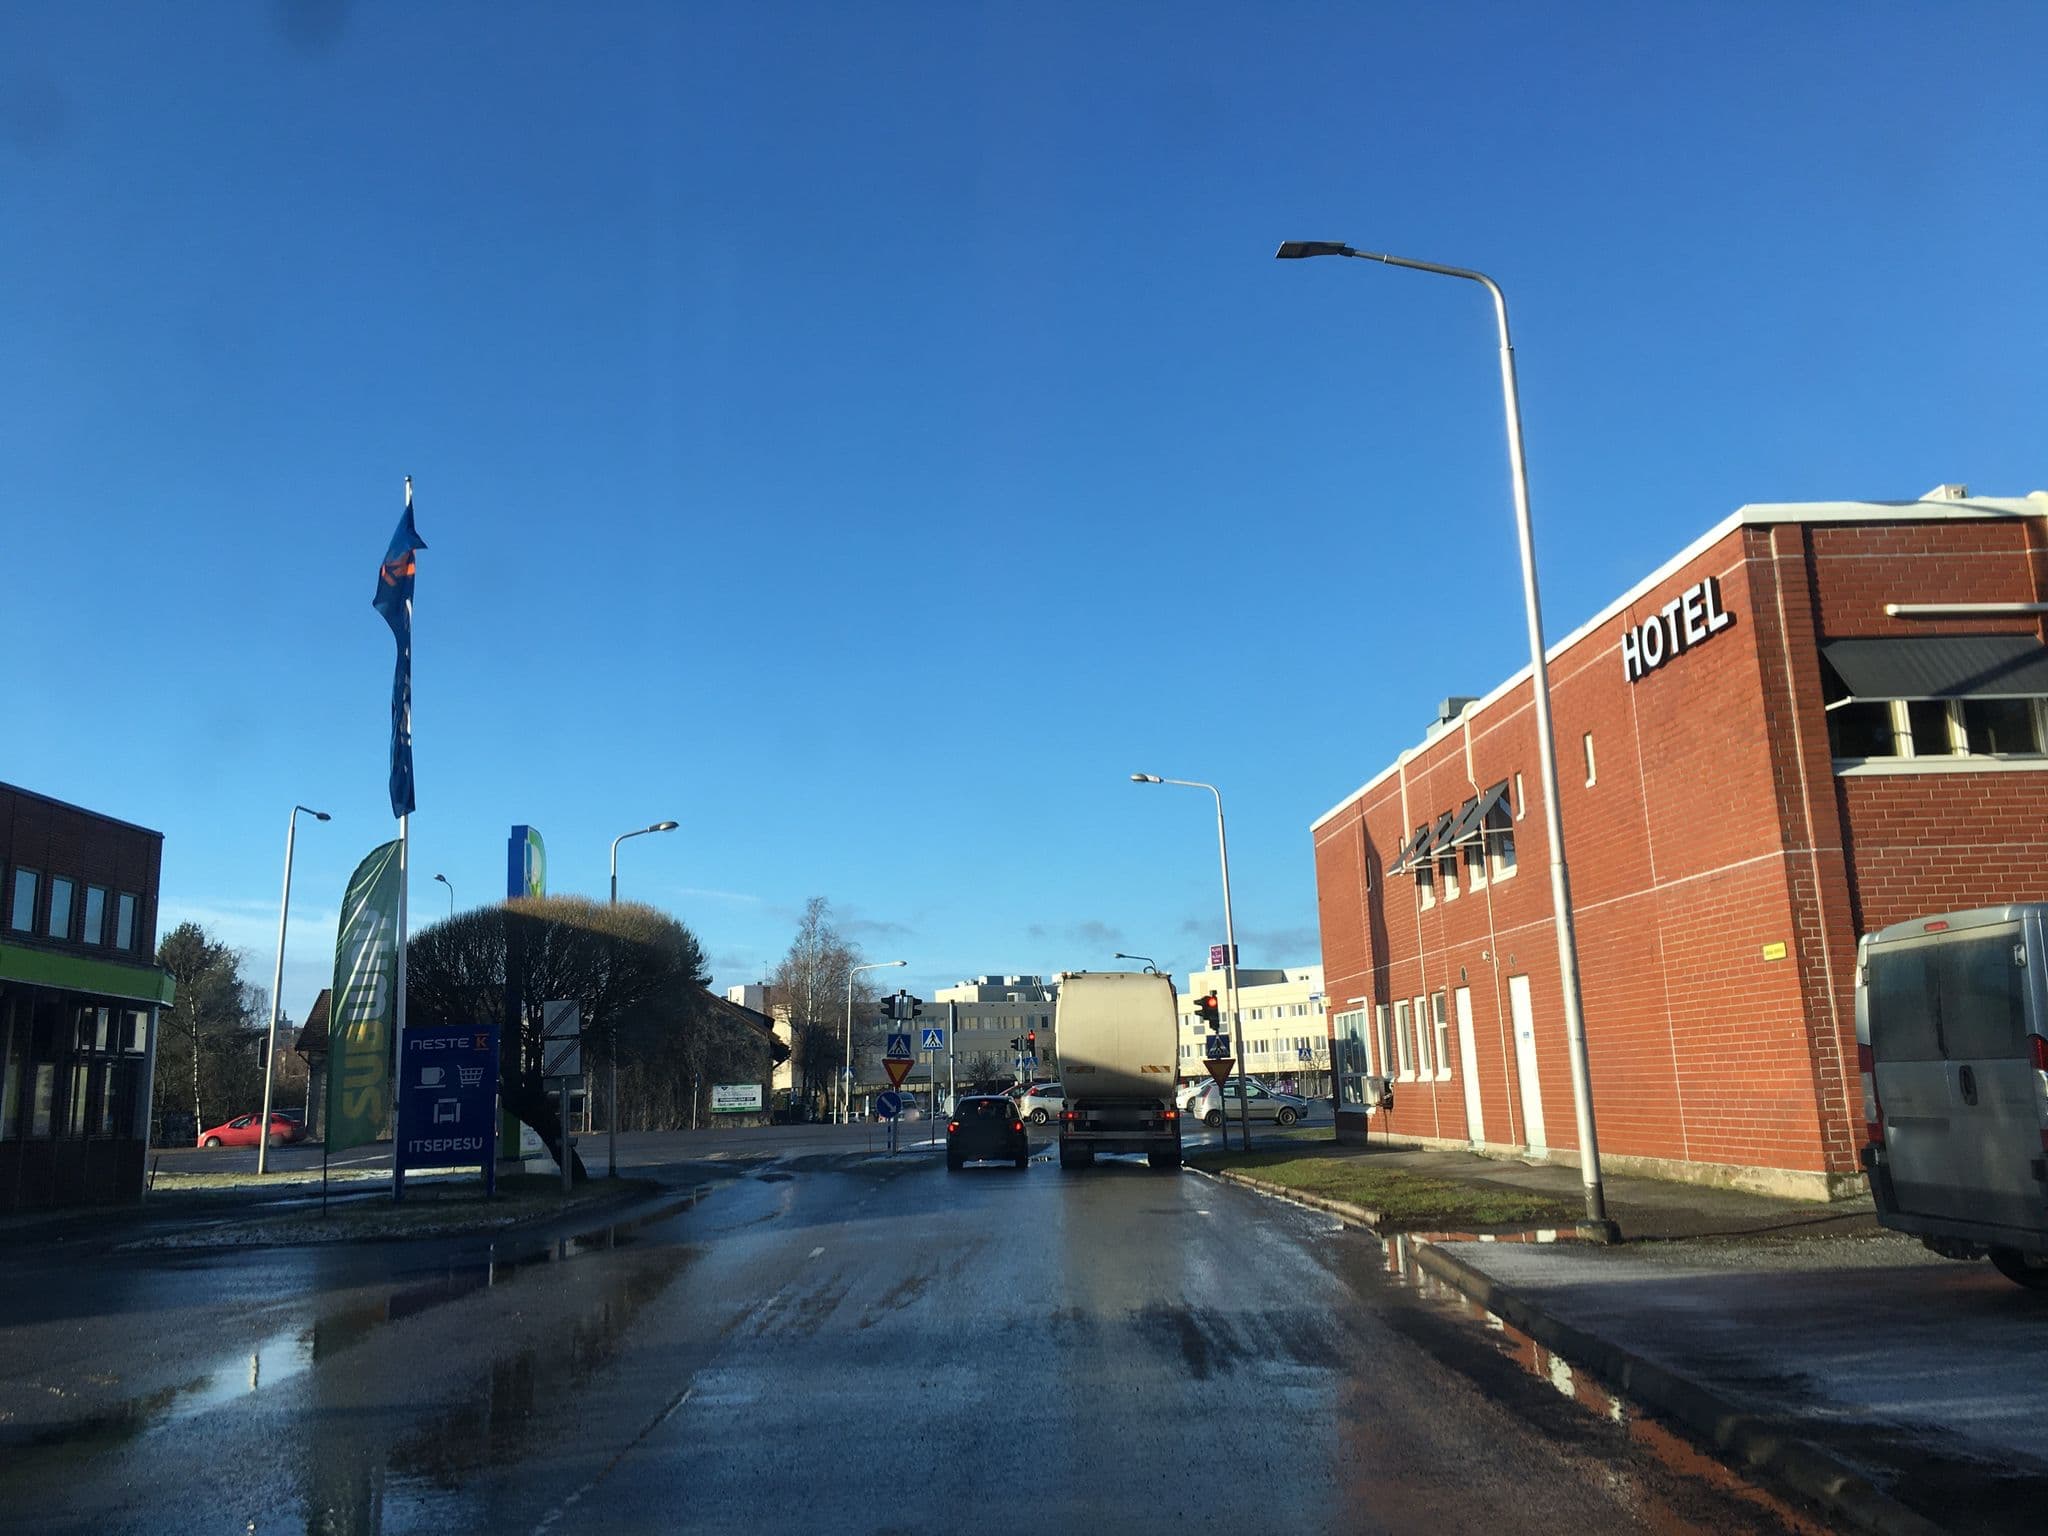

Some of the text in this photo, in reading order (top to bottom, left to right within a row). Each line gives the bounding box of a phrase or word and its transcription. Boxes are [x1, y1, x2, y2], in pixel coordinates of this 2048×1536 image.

[1621, 577, 1730, 683] HOTEL
[342, 899, 391, 1121] SUBWAY
[410, 1035, 488, 1050] NESTE K
[408, 1137, 483, 1153] ITSEPESU
